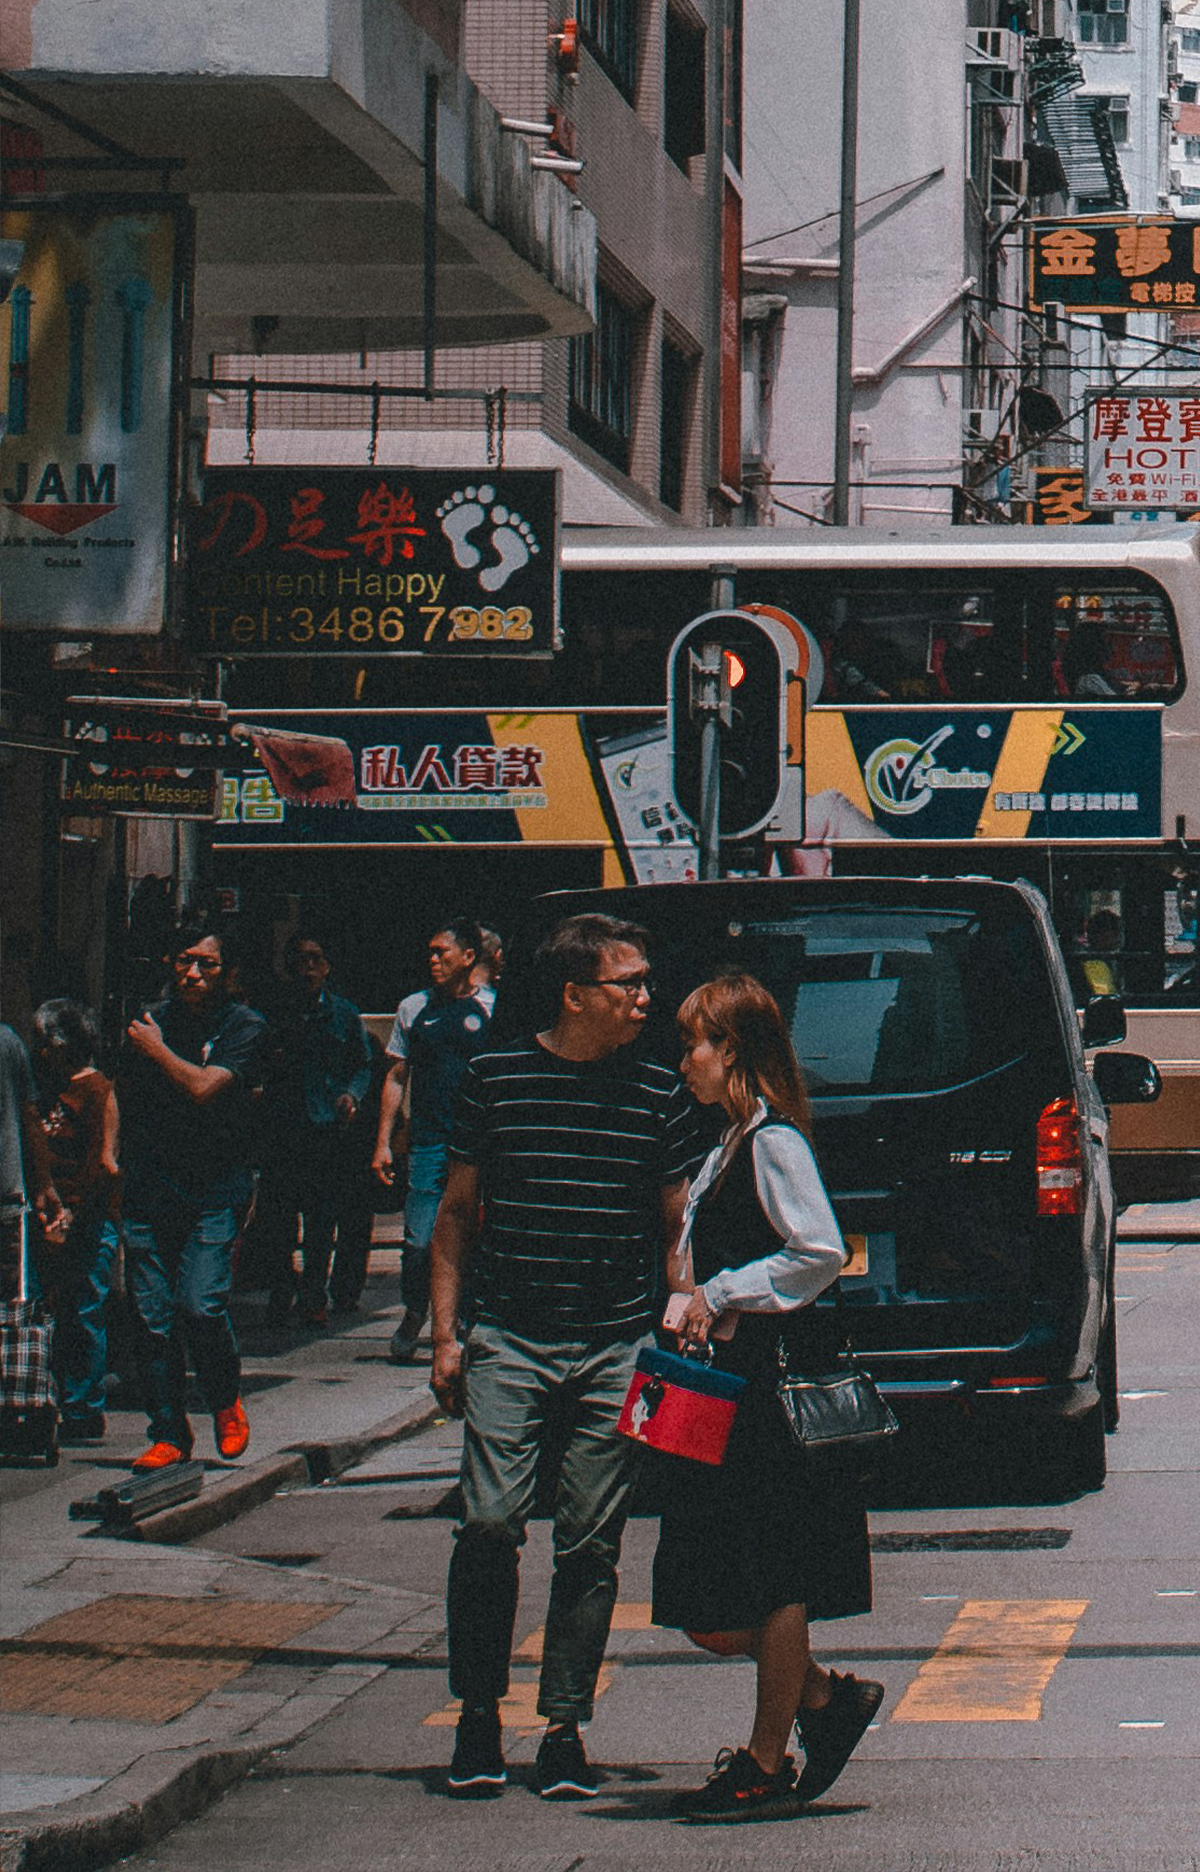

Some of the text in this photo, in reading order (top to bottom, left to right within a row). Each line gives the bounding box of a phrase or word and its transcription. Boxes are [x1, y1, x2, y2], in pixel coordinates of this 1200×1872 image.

[3, 462, 117, 504] JAM
[338, 568, 446, 603] Happy
[361, 744, 545, 791] 私人貸款
[71, 780, 209, 808] Authentic Massage
